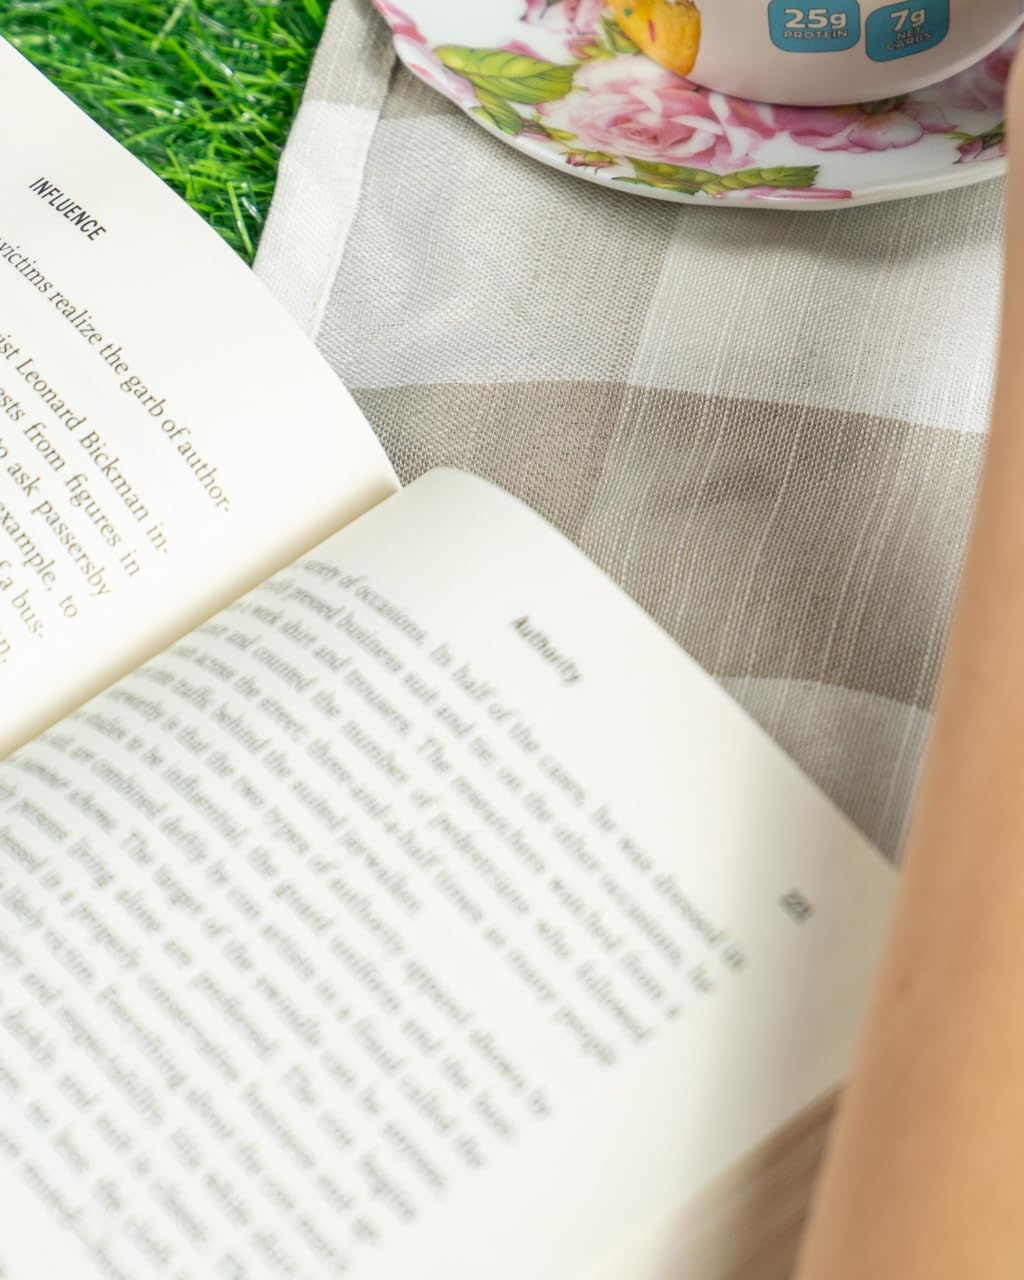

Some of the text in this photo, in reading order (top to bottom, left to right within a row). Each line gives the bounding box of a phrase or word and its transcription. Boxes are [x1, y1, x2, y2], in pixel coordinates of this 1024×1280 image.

[784, 8, 847, 30] 25g
[784, 29, 848, 40] PROTEIN
[887, 32, 932, 51] CARBS
[889, 8, 926, 32] 7g
[896, 27, 922, 40] NET
[29, 177, 107, 241] INFLUENCE
[0, 242, 231, 513] victims realize the garb of author-
[16, 358, 87, 431] Leonard
[79, 431, 149, 522] Bickman
[146, 522, 169, 554] in-
[23, 422, 67, 472] from
[65, 472, 122, 548] figures
[119, 548, 141, 577] in
[8, 463, 41, 497] ask
[31, 500, 112, 598] passersby
[11, 588, 44, 639] bus-
[59, 594, 78, 618] to
[511, 616, 580, 684] Authority
